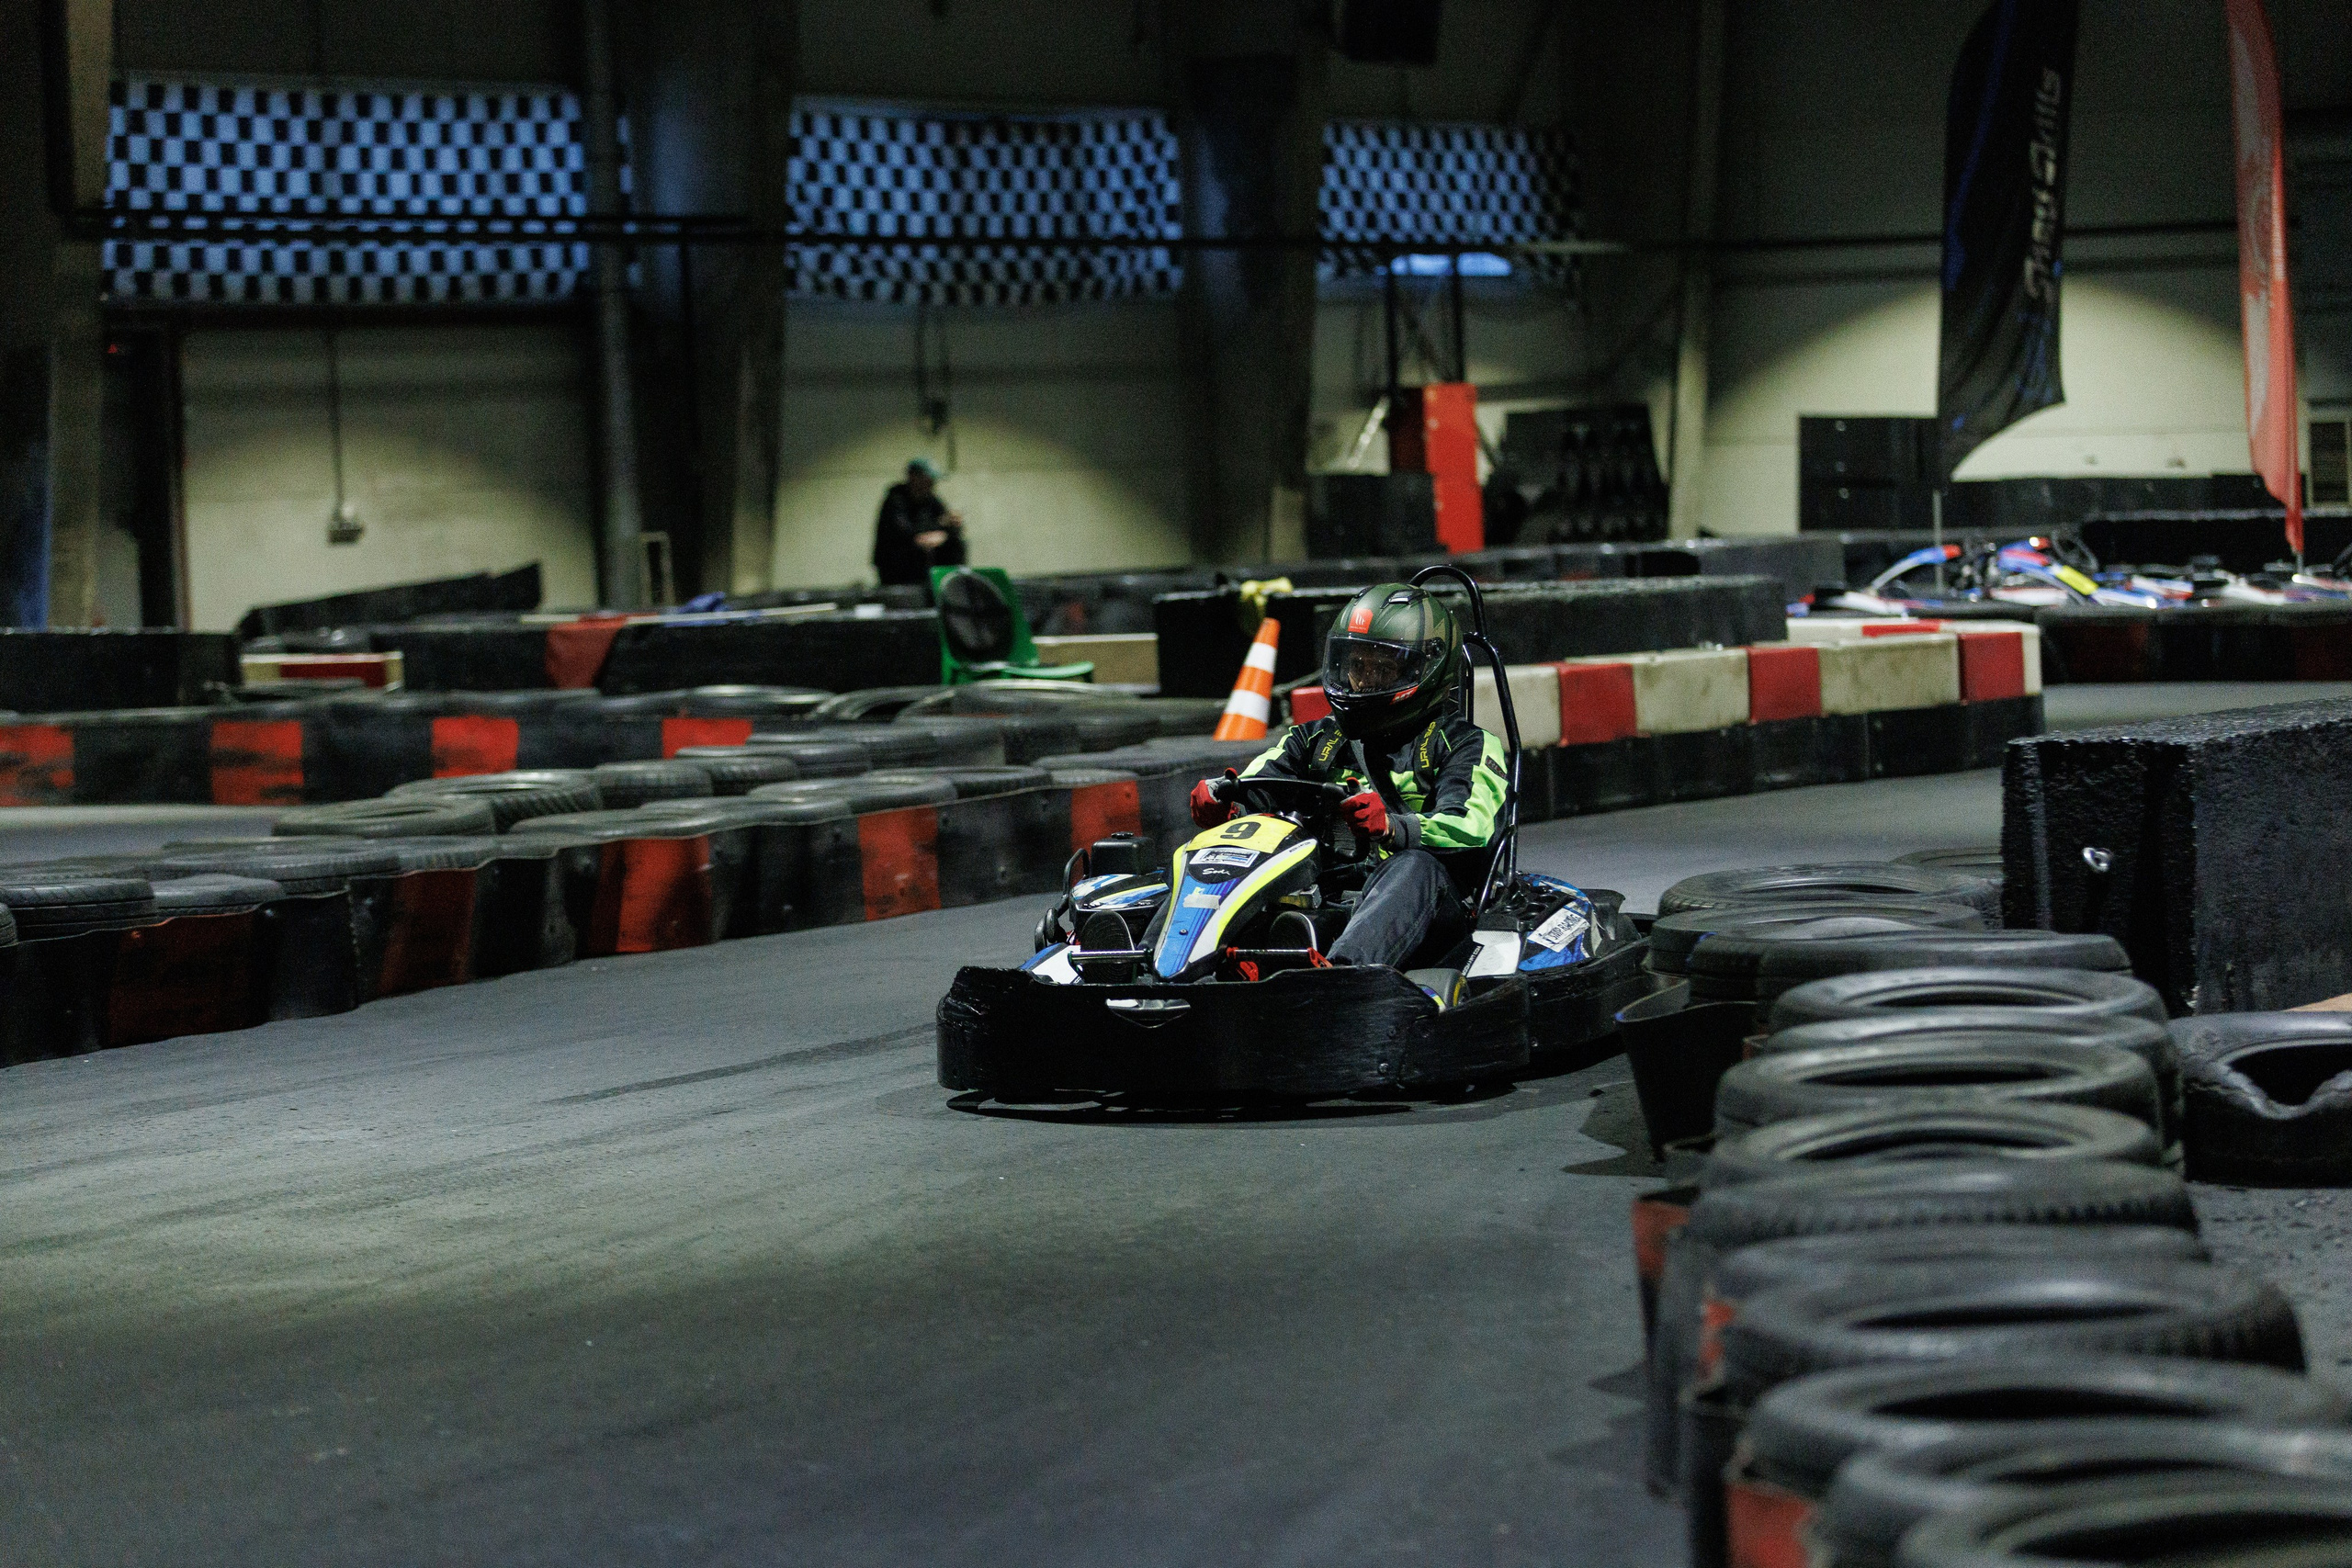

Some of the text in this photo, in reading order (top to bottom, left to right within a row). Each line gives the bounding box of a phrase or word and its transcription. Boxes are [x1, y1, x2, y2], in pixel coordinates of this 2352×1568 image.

[1318, 738, 1339, 761] URAL
[1419, 740, 1430, 769] URAL
[1220, 821, 1261, 840] 9
